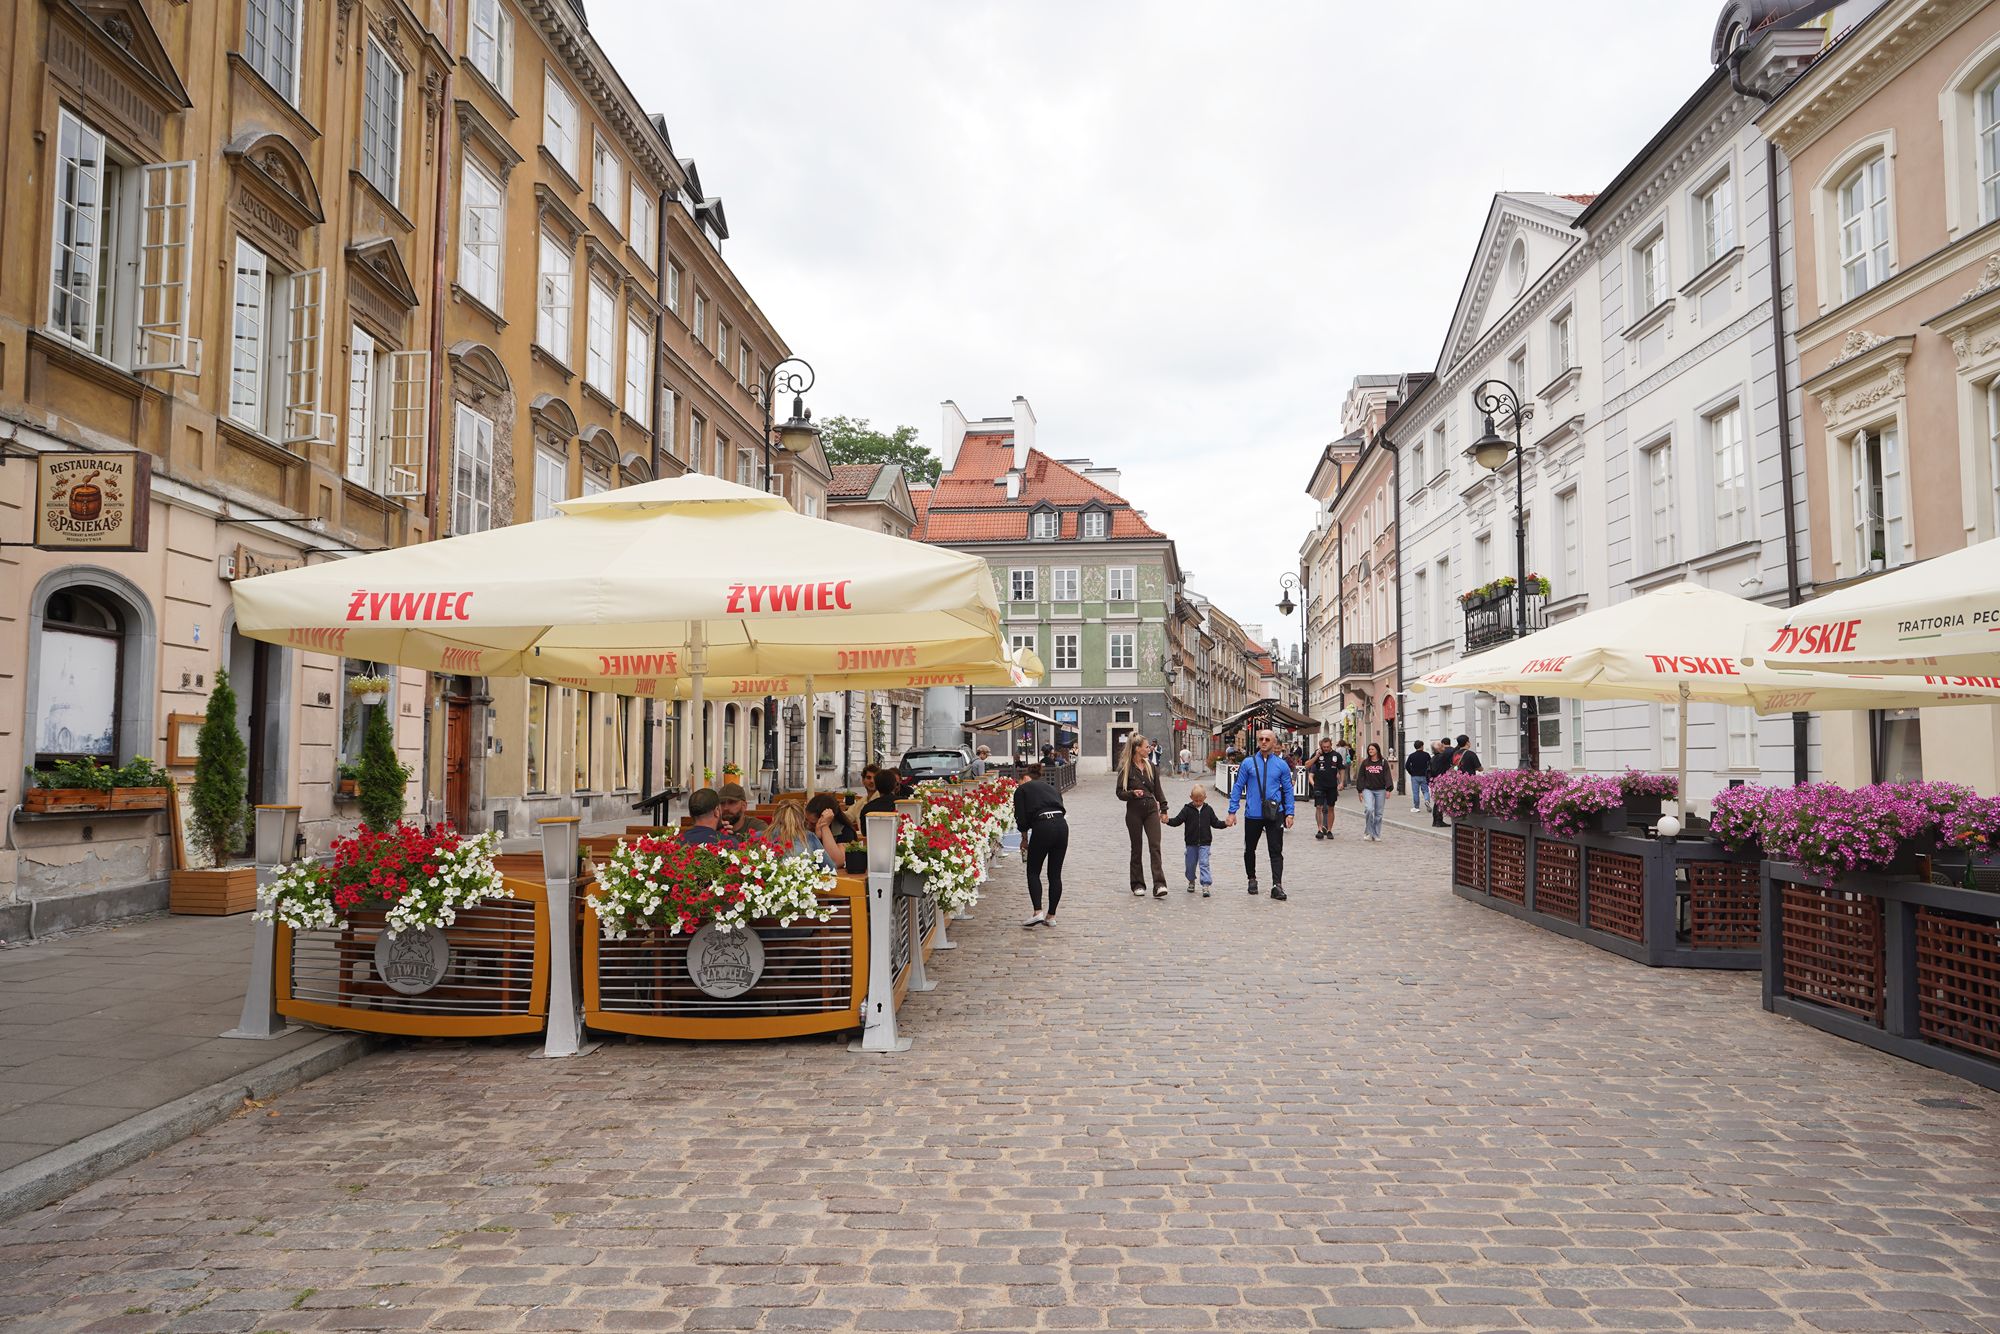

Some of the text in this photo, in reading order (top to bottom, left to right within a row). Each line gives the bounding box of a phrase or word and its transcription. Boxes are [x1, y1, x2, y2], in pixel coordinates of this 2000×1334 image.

[49, 459, 123, 475] RESTAURACJA
[58, 516, 113, 532] PASIEKA
[346, 589, 473, 621] ŻYWIEC
[726, 580, 852, 613] ŻYWIEC
[1898, 615, 1964, 633] TRATTORIA
[1767, 620, 1862, 654] TYSKIE
[1520, 656, 1572, 674] TYSKIE
[1645, 655, 1741, 675] TYSKIE
[1017, 695, 1128, 705] PODKOMORZANKA
